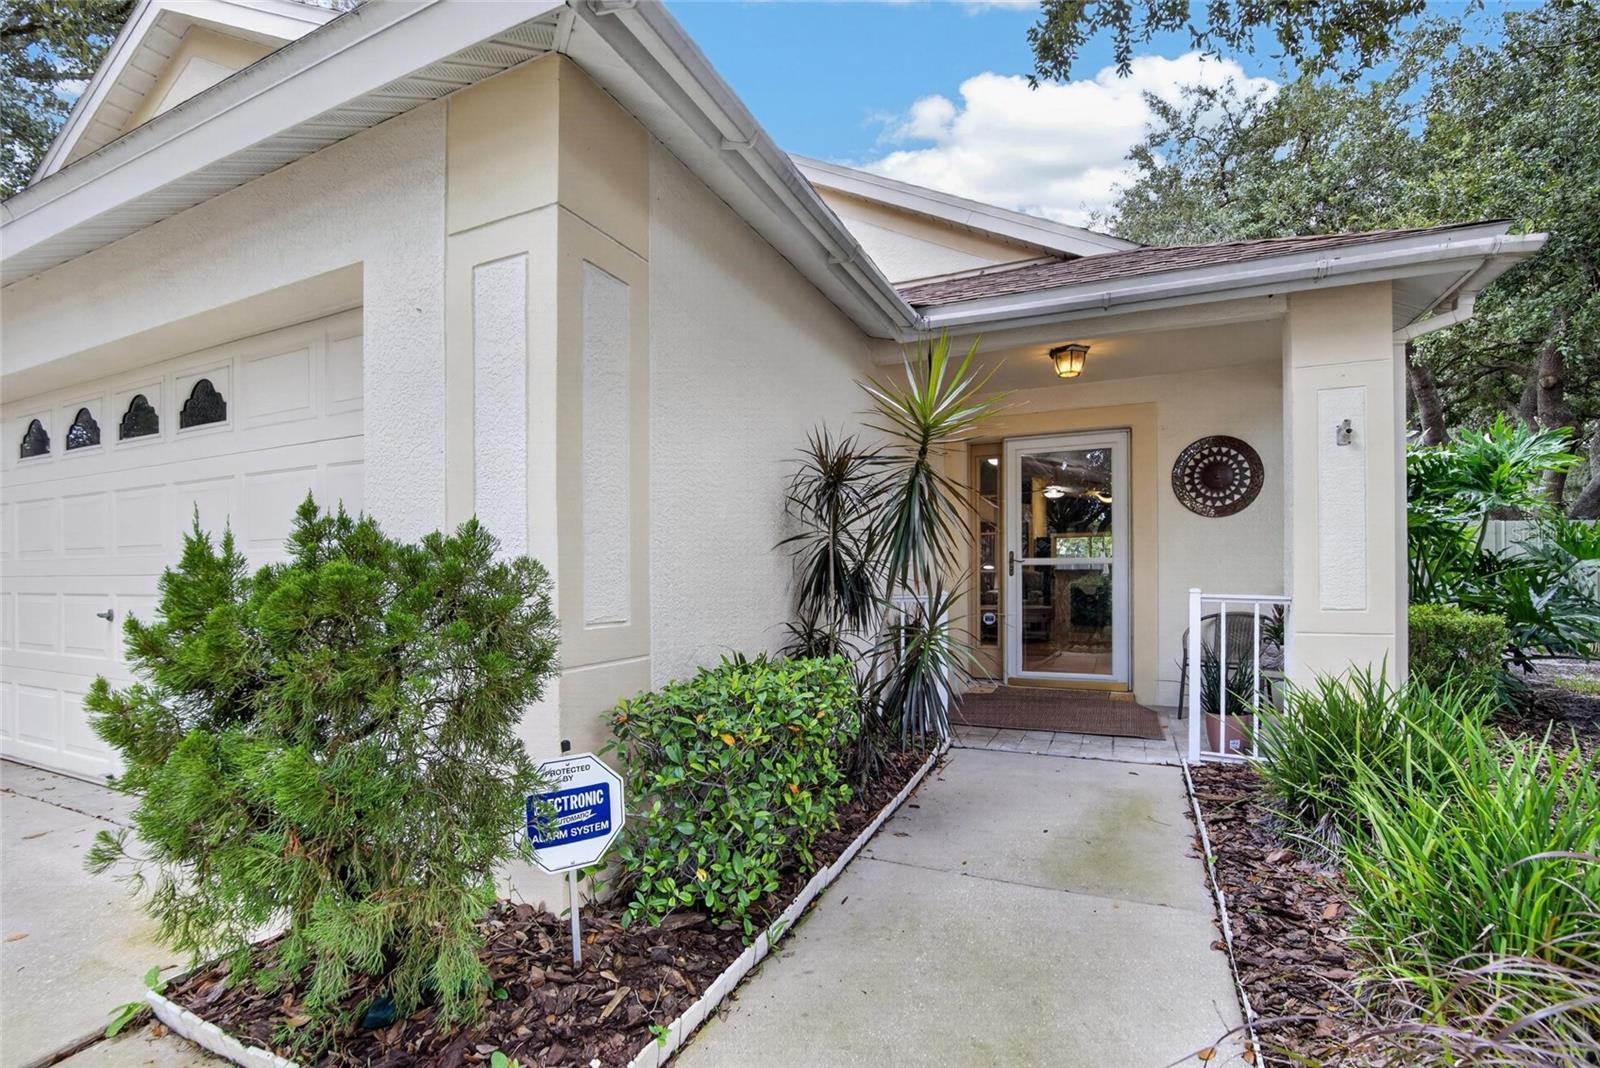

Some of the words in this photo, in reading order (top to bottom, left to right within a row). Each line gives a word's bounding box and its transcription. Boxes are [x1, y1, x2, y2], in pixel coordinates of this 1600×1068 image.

[544, 764, 591, 777] PROTECTED
[562, 774, 574, 782] BY
[534, 789, 604, 816] CTRONIC
[557, 811, 590, 825] TOMATIC
[570, 820, 610, 837] SYSTEM
